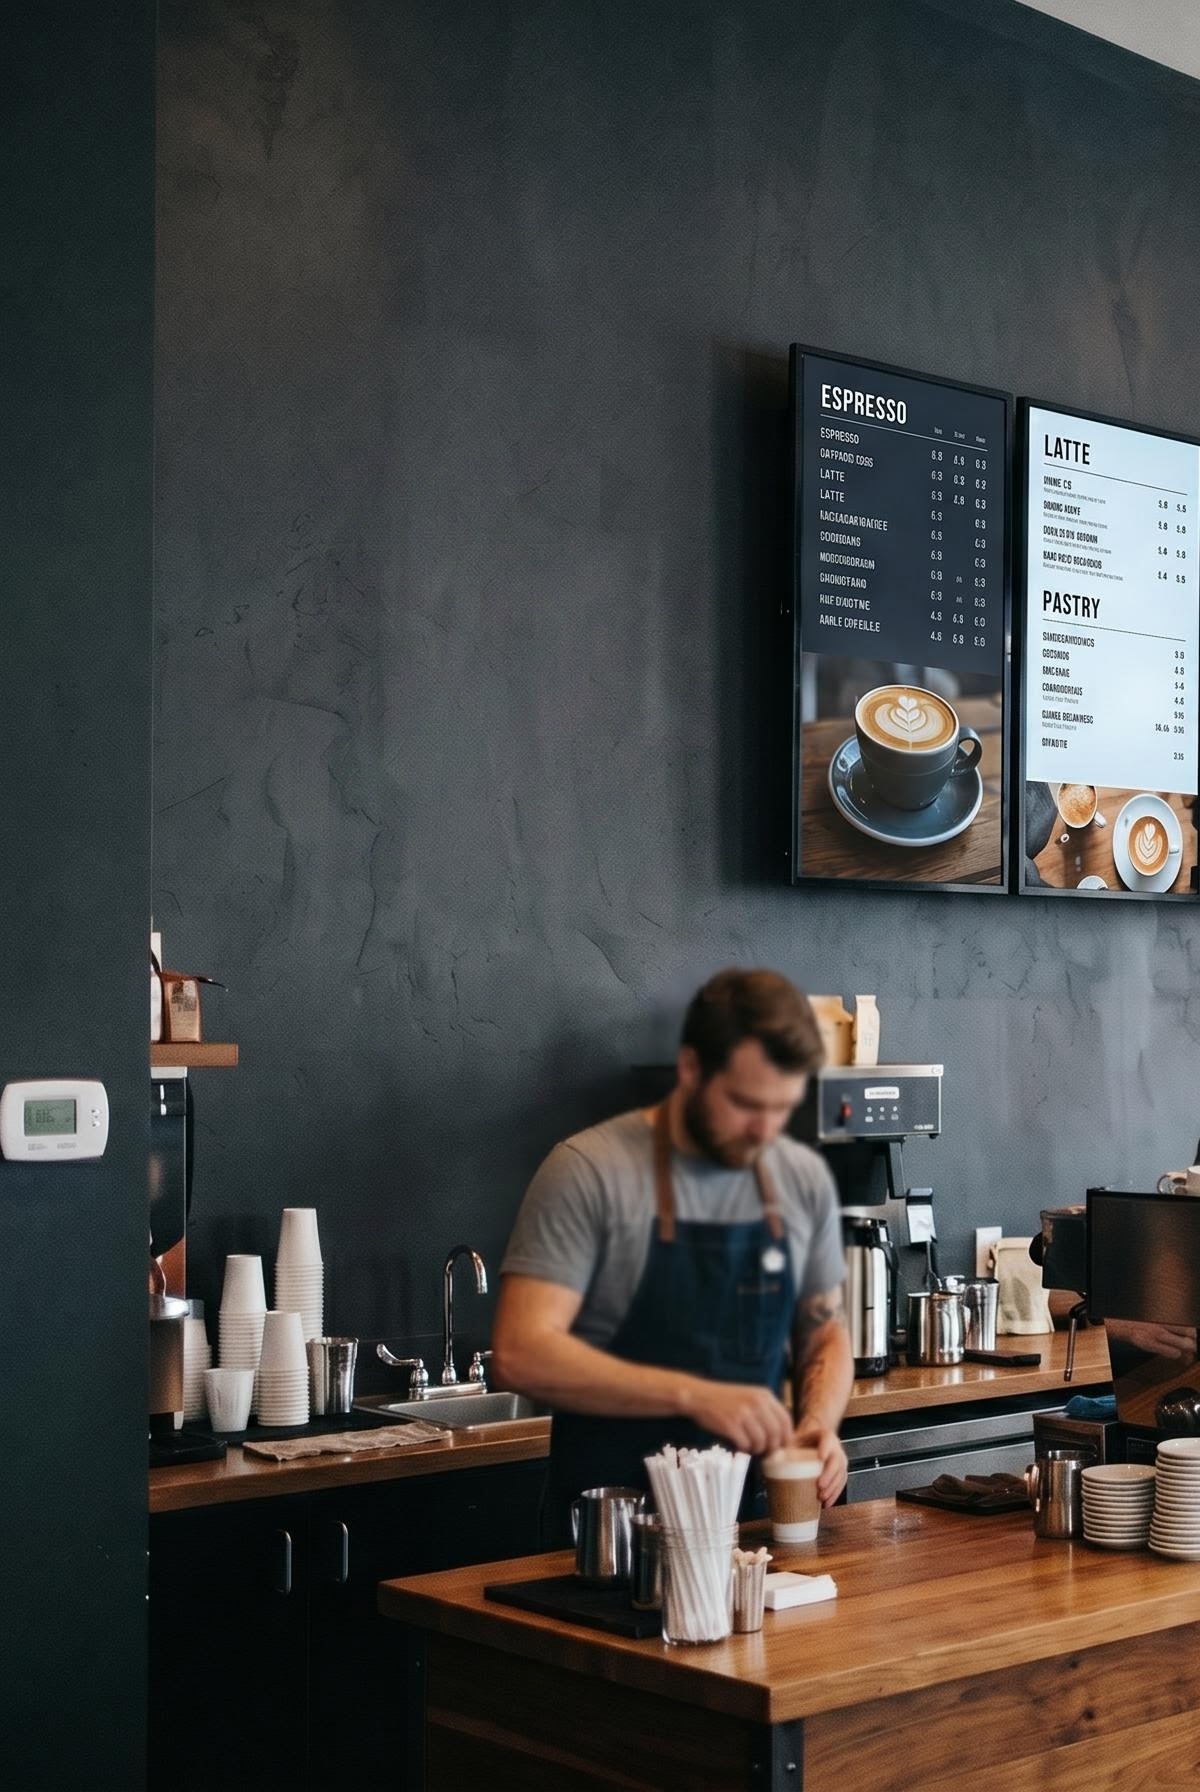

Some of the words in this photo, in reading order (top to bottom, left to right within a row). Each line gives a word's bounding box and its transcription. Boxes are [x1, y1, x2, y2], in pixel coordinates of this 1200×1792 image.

[821, 383, 907, 424] ESPRESSO
[820, 427, 859, 444] ESPRESSO
[1044, 434, 1091, 465] LATTE
[820, 468, 845, 482] LATTE
[820, 489, 845, 503] LATTE
[1043, 590, 1101, 619] PASTRY
